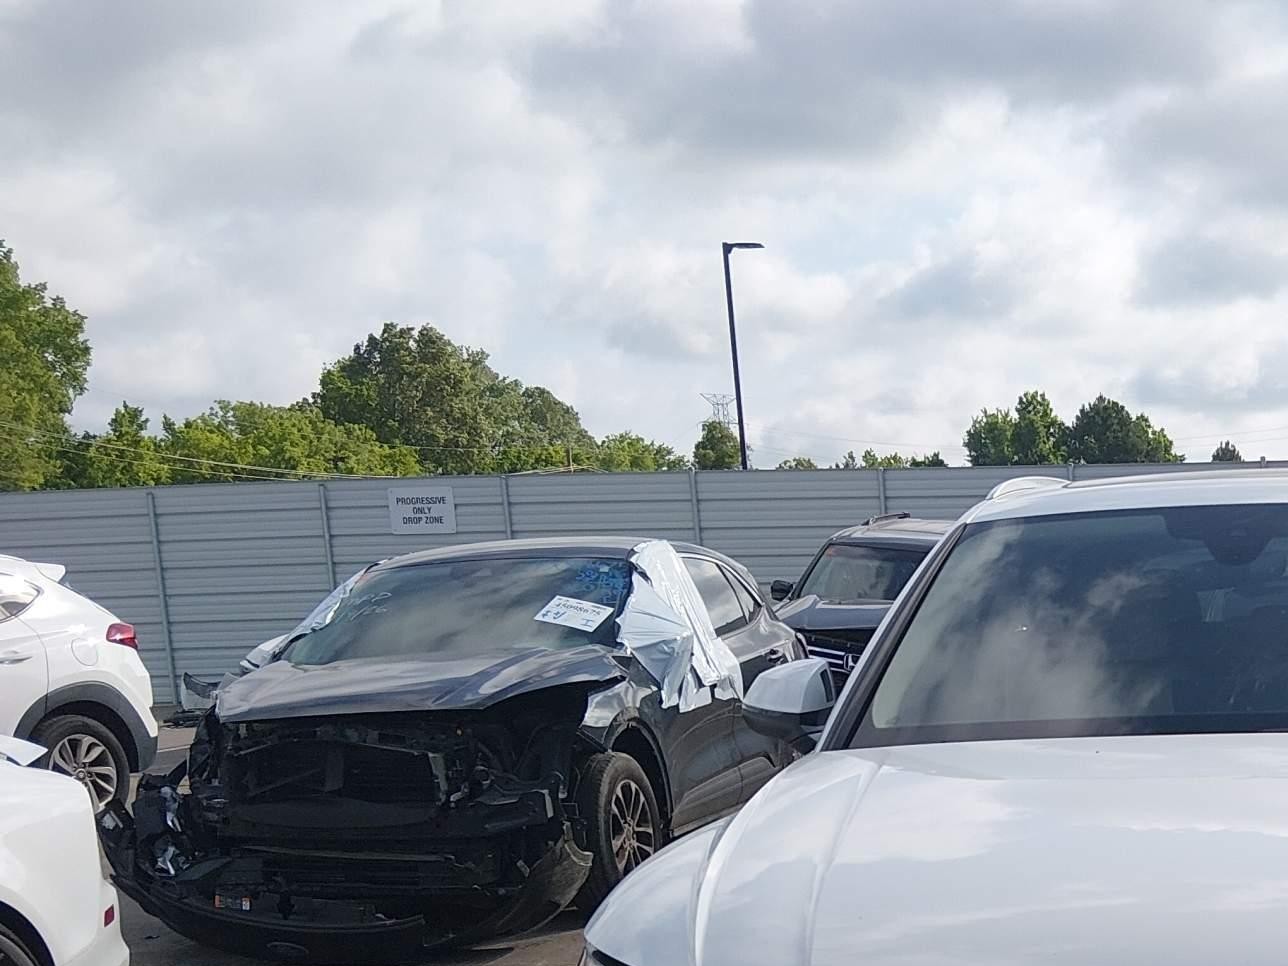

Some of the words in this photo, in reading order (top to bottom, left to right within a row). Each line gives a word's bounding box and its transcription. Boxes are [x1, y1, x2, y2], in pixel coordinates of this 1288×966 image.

[395, 496, 447, 505] PROGRESSIVE
[412, 506, 432, 515] ONLY
[402, 516, 423, 525] DROP
[424, 516, 444, 525] ZONE
